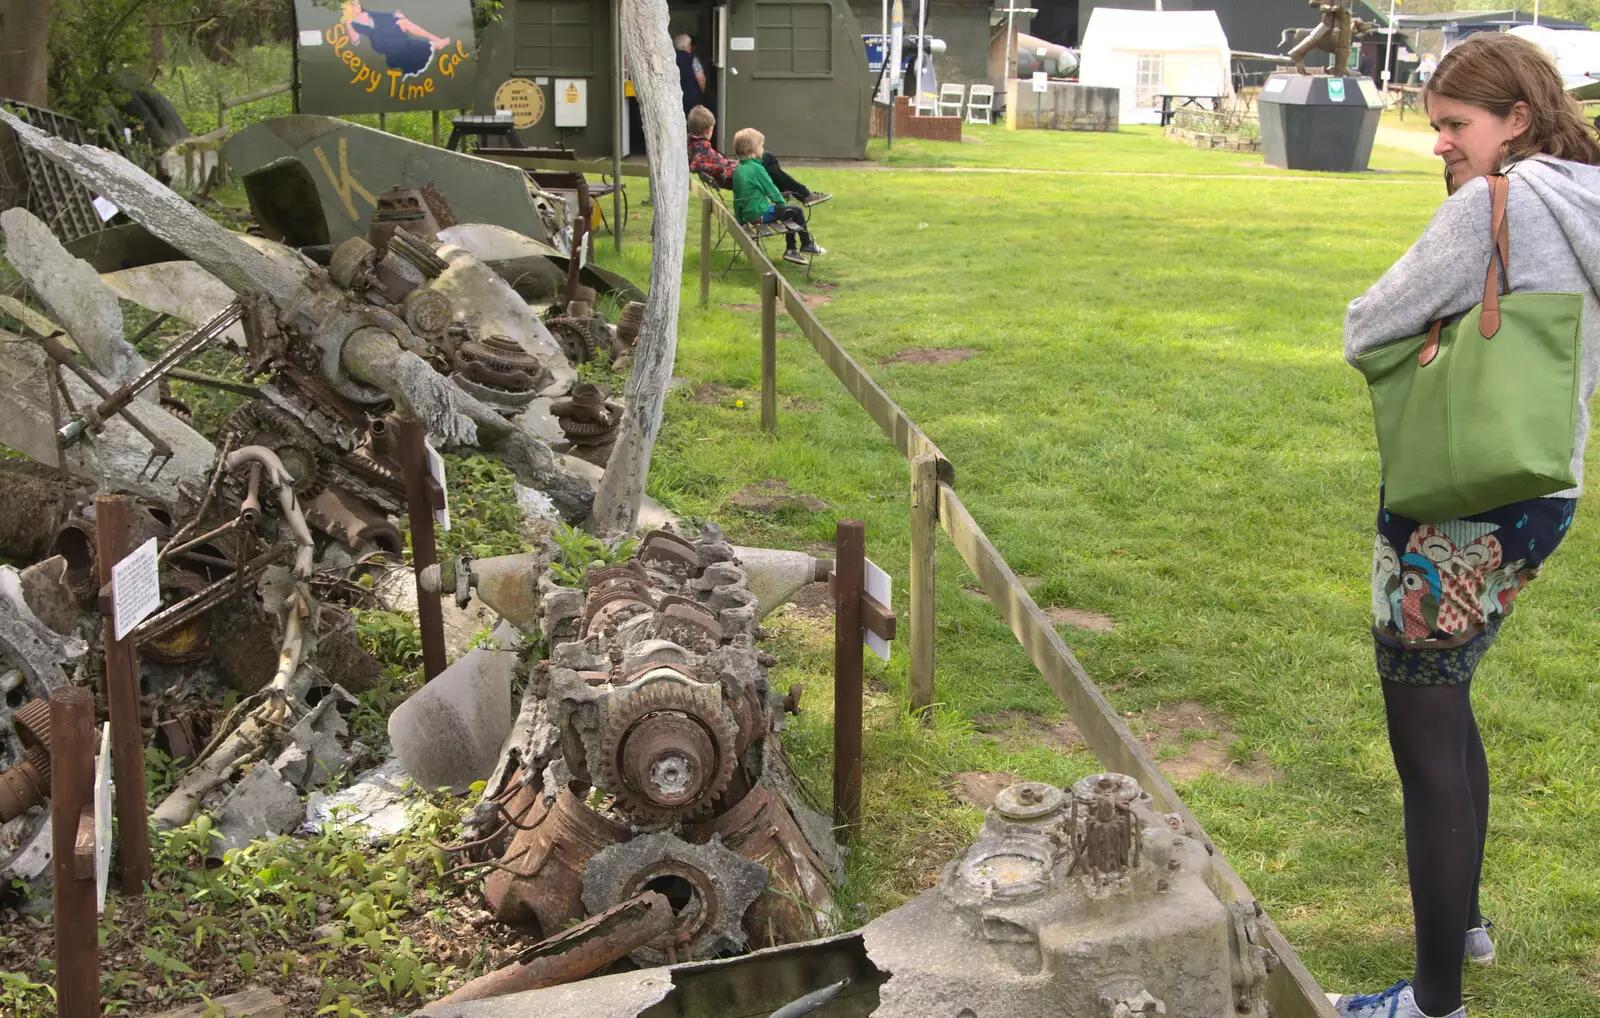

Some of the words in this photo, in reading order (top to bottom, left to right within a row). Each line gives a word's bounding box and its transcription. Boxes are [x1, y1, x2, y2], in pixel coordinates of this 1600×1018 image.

[325, 23, 382, 92] Sleepy
[386, 69, 435, 100] Time
[438, 39, 470, 79] Gal
[312, 136, 377, 220] K
